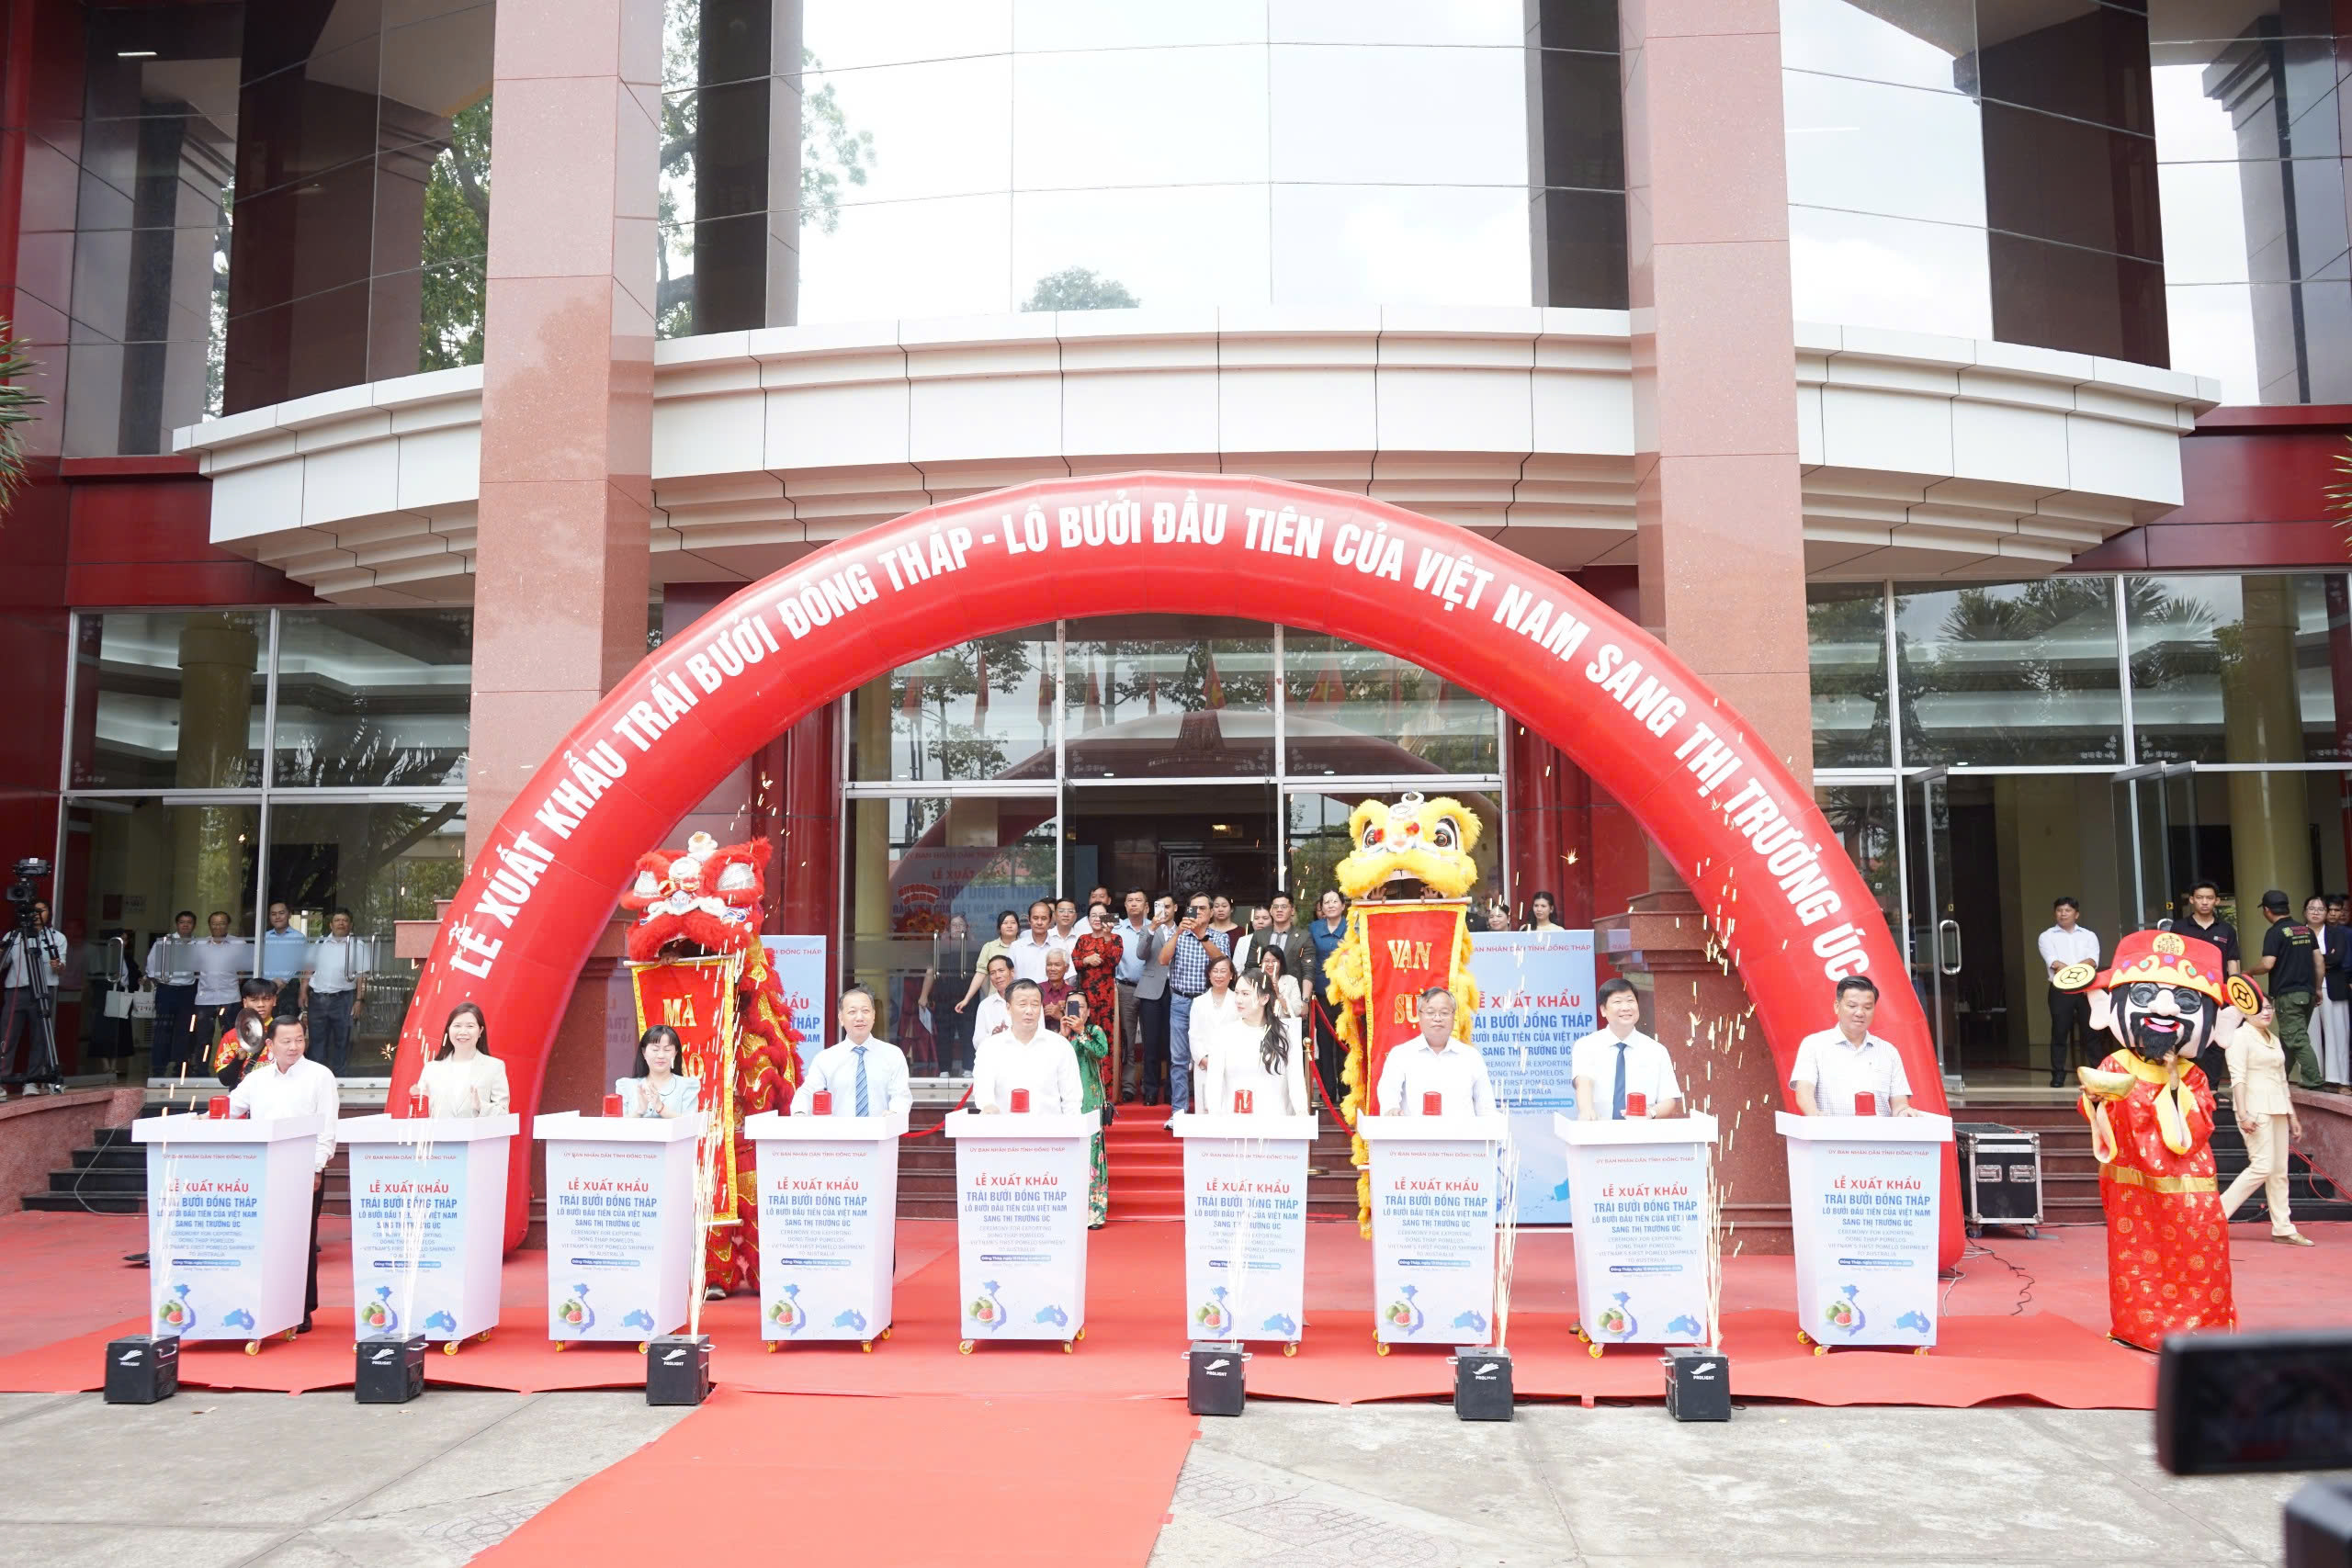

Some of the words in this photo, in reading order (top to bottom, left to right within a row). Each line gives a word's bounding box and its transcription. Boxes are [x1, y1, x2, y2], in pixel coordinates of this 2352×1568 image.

[1058, 489, 1141, 548] BƯỞI
[1152, 489, 1227, 545] ĐẦU
[1002, 504, 1048, 555] LÔ
[1243, 505, 1324, 559] TIÊN
[877, 525, 974, 591] THÁP
[1331, 521, 1405, 581] CỦA
[1413, 547, 1495, 612] VIỆT
[1492, 583, 1590, 662] NAM
[686, 611, 780, 693] BƯỞI
[1585, 643, 1687, 738] SANG
[613, 674, 698, 752] TRÁI
[1674, 722, 1744, 797] THỊ
[535, 739, 628, 840] KHẨU
[1723, 777, 1842, 926] TRƯỜNG
[474, 830, 555, 929] XUẤT
[449, 919, 503, 979] LỄ
[1387, 940, 1432, 974] VẠN
[1813, 921, 1870, 982] ÚC
[1537, 988, 1580, 1008] KHẨU
[662, 994, 696, 1027] MÃ
[1491, 1011, 1519, 1028] BƯỞI
[1561, 1011, 1592, 1027] THÁP
[1492, 1031, 1510, 1043] ĐẦU
[1534, 1030, 1550, 1042] CỦA
[1553, 1031, 1570, 1043] VIỆT
[1483, 1046, 1505, 1056] SANG
[1560, 1043, 1571, 1055] ÚC
[218, 1179, 249, 1192] KHẨU
[370, 1179, 380, 1192] LỄ
[385, 1180, 413, 1192] XUẤT
[569, 1178, 579, 1190] LỄ
[583, 1179, 613, 1191] XUẤT
[617, 1178, 649, 1191] KHẨU
[777, 1177, 788, 1190] LỄ
[793, 1178, 821, 1190] XUẤT
[827, 1177, 858, 1190] KHẨU
[976, 1172, 987, 1185] LỄ
[991, 1173, 1021, 1185] XUẤT
[1025, 1172, 1057, 1185] KHẨU
[1207, 1179, 1217, 1190] LỄ
[1257, 1179, 1290, 1193] KHẨU
[1395, 1177, 1406, 1190] LỄ
[1411, 1178, 1442, 1190] XUẤT
[1446, 1178, 1478, 1190] KHẨU
[1835, 1176, 1846, 1189] LỄ
[1850, 1177, 1883, 1189] XUẤT
[1887, 1177, 1921, 1190] KHẨU
[967, 1190, 987, 1201] TRÁI
[990, 1190, 1012, 1201] BƯỞI
[1014, 1190, 1040, 1201] ĐỒNG
[1044, 1190, 1067, 1201] THÁP
[1603, 1184, 1614, 1196] LỄ
[1619, 1183, 1650, 1196] XUẤT
[1655, 1182, 1688, 1195] KHẨU
[183, 1197, 203, 1207] BƯỞI
[207, 1195, 231, 1207] ĐỒNG
[234, 1195, 257, 1207] THÁP
[361, 1198, 379, 1208] TRÁI
[435, 1198, 457, 1208] THÁP
[560, 1195, 579, 1204] TRÁI
[582, 1195, 603, 1206] BƯỞI
[606, 1195, 630, 1206] ĐỒNG
[634, 1196, 657, 1207] THÁP
[769, 1194, 787, 1204] TRÁI
[792, 1195, 812, 1205] BƯỞI
[816, 1194, 841, 1205] ĐỒNG
[844, 1195, 866, 1206] THÁP
[1197, 1195, 1217, 1206] TRÁI
[1275, 1197, 1298, 1209] THÁP
[1385, 1195, 1406, 1204] TRÁI
[1409, 1195, 1430, 1205] BƯỞI
[1434, 1195, 1460, 1206] ĐỒNG
[1464, 1196, 1487, 1206] THÁP
[1594, 1202, 1614, 1213] TRÁI
[1619, 1201, 1640, 1213] BƯỞI
[1644, 1201, 1669, 1212] ĐỒNG
[1674, 1201, 1697, 1211] THÁP
[1825, 1193, 1846, 1203] TRÁI
[1850, 1193, 1871, 1204] BƯỞI
[1876, 1192, 1902, 1205] ĐỒNG
[1906, 1194, 1930, 1205] THÁP
